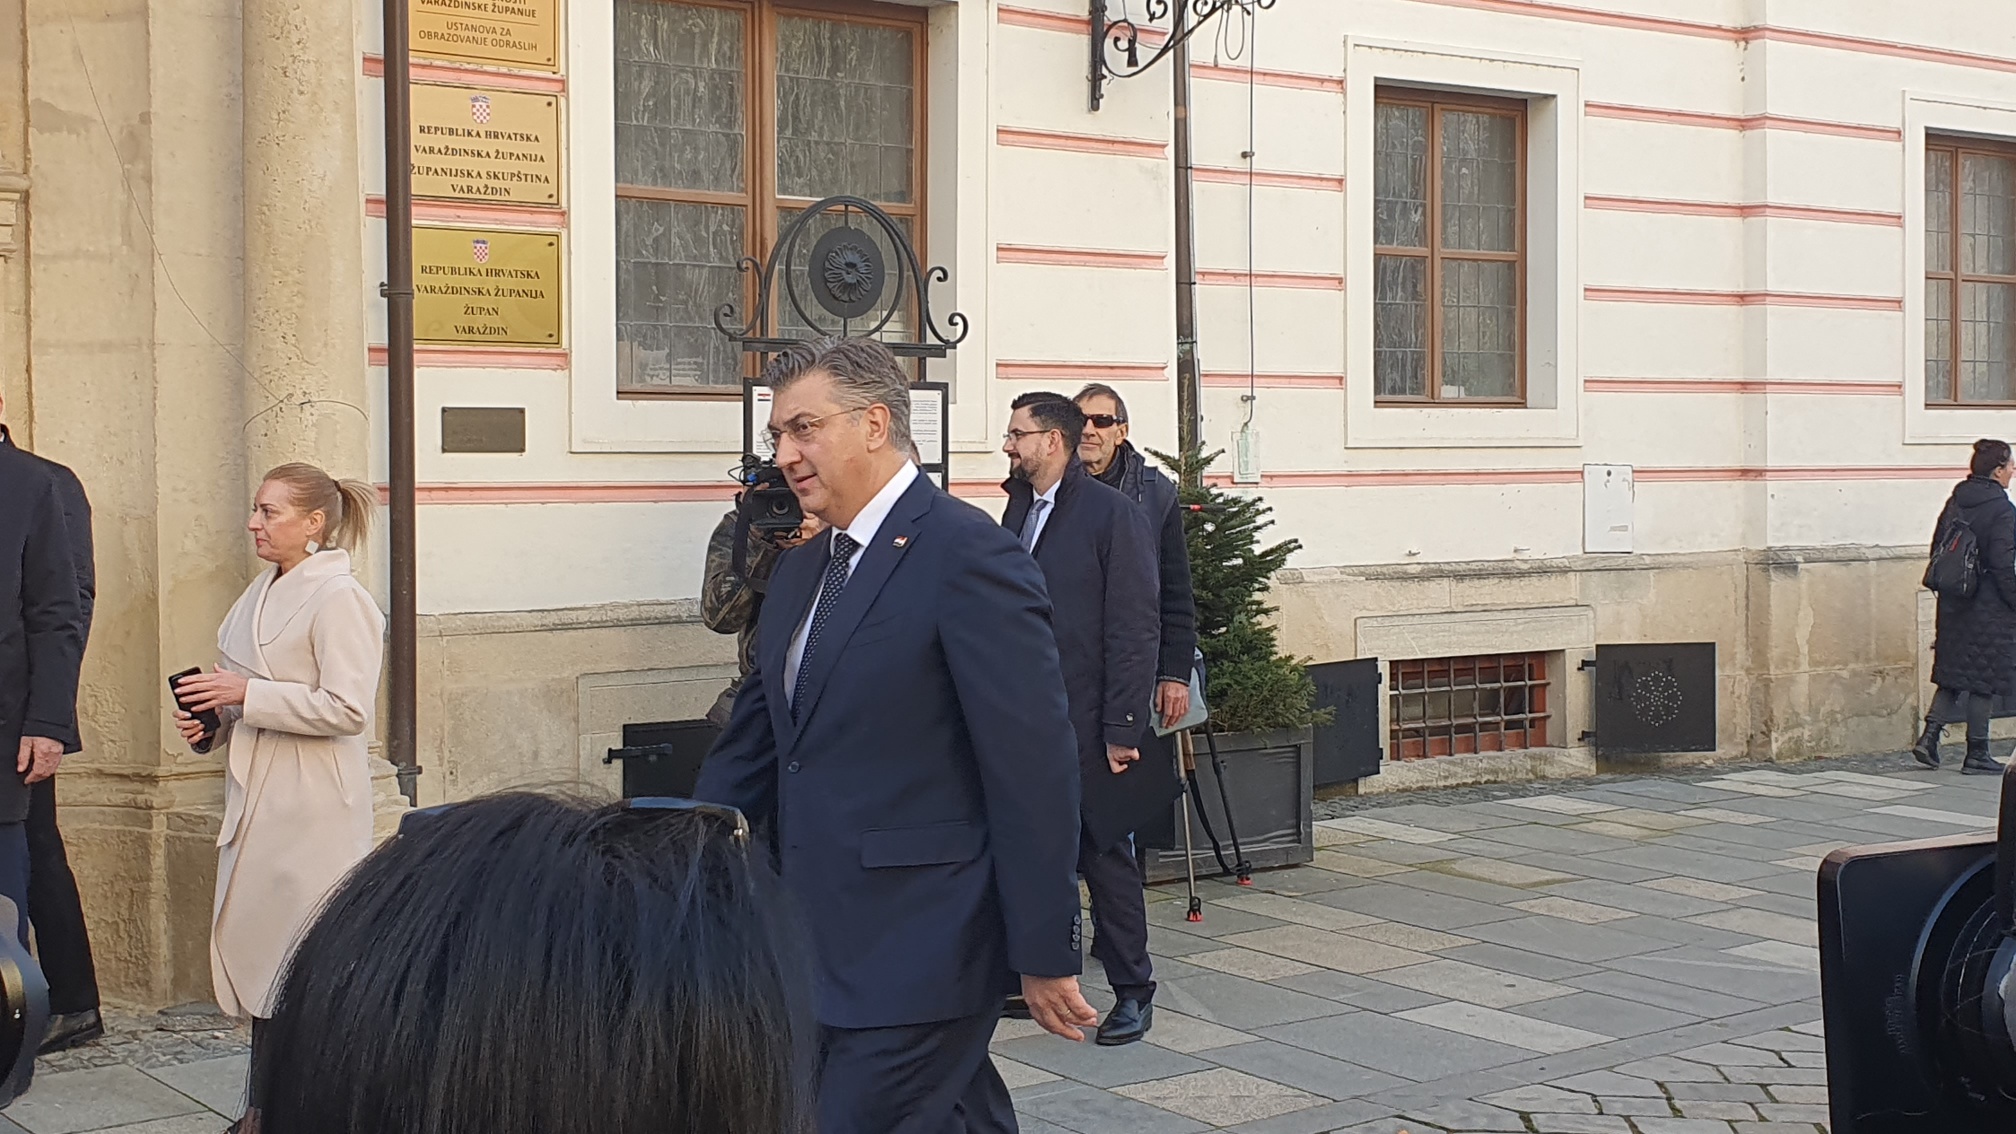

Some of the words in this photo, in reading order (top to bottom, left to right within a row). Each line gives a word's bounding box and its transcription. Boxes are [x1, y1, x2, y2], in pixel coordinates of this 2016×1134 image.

[491, 2, 537, 18] ŽUPANIJE
[446, 21, 497, 36] USTANOVA
[500, 27, 512, 37] ZA
[418, 30, 488, 46] OBRAZOVANJE
[491, 39, 538, 51] ODRASLIH
[419, 125, 482, 139] REPUBLIKA
[485, 130, 540, 143] HRVATSKA
[414, 144, 491, 159] VARAŽDINSKA
[494, 149, 545, 163] ŽUPANIJA
[410, 163, 483, 180] ŽUPANIJSKA
[486, 171, 550, 184] SKUPŠTINA
[450, 184, 511, 197] VARAŽDIN
[420, 265, 483, 277] REPUBLIKA
[485, 268, 540, 280] HRVATSKA
[416, 283, 491, 297] VARAŽDINSKA
[494, 286, 545, 299] ŽUPANIJA
[463, 304, 499, 317] ŽUPAN
[454, 324, 508, 336] VARAŽDIN
